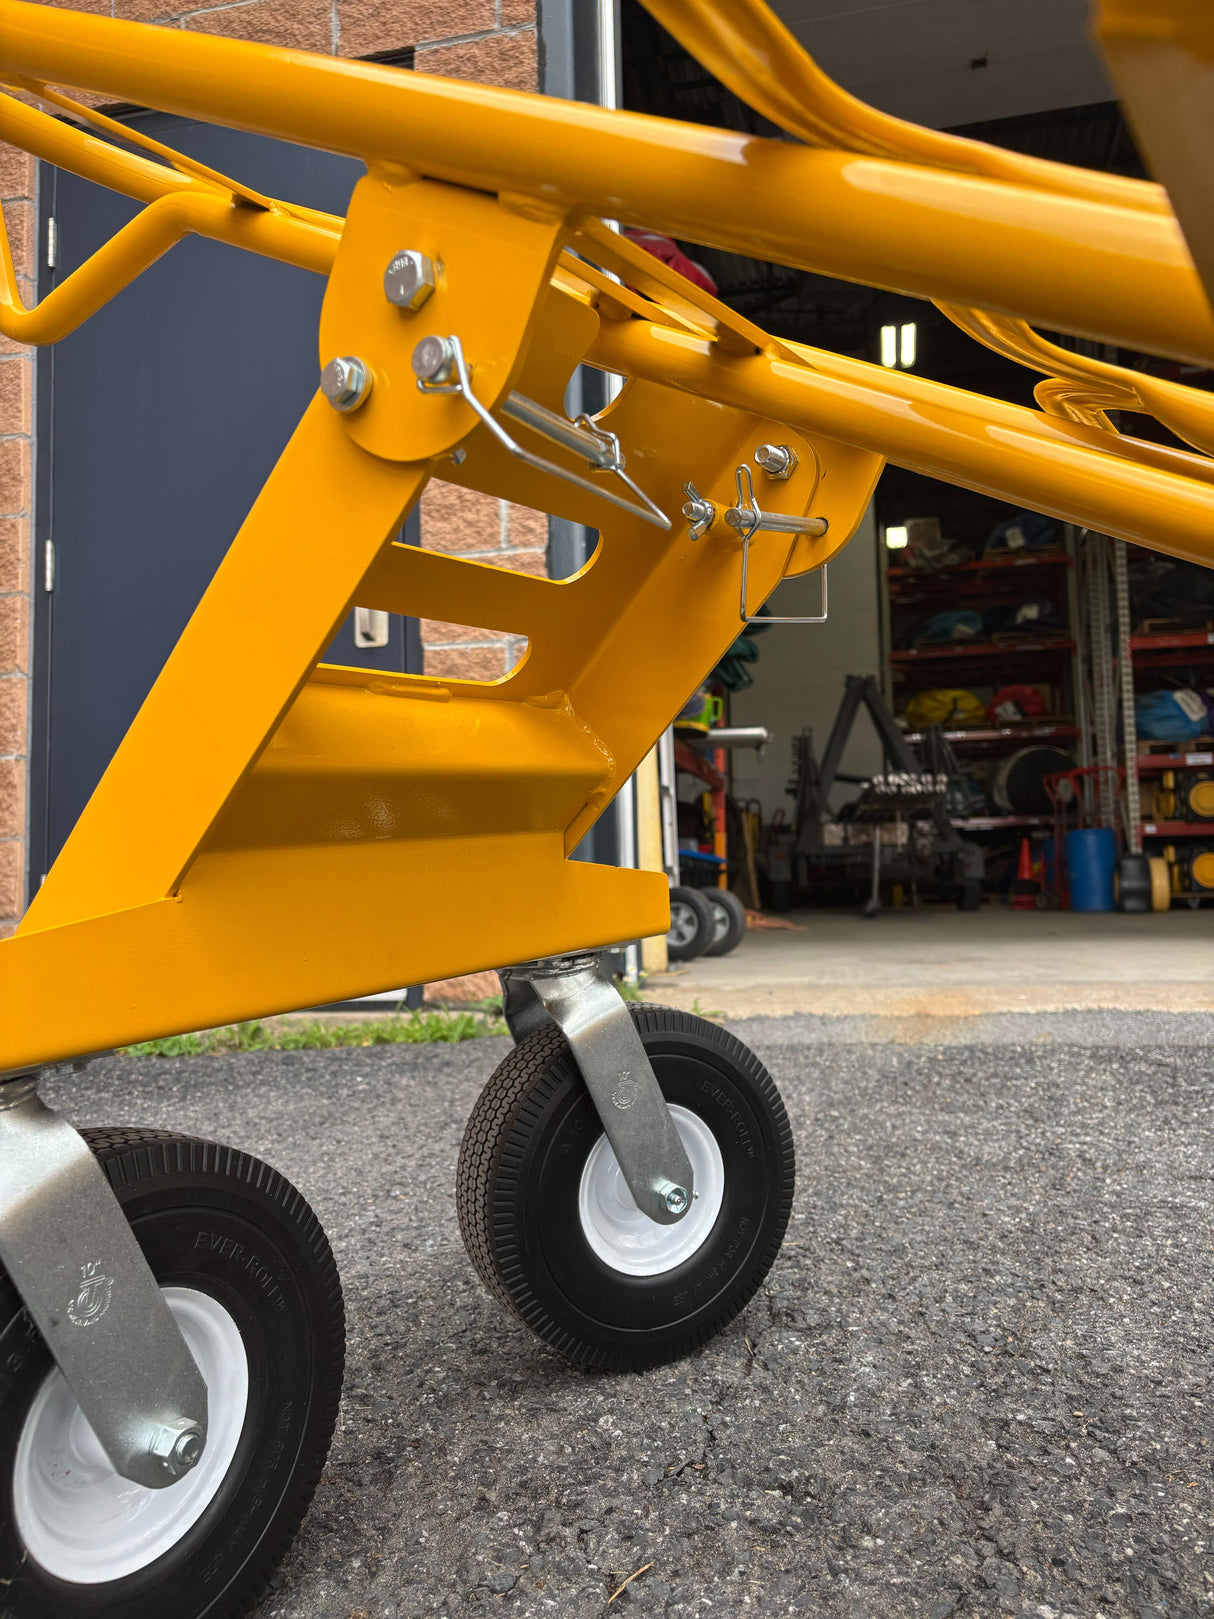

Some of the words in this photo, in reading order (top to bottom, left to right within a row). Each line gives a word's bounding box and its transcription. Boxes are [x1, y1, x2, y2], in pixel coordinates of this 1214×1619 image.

[724, 1240, 740, 1260] FOR
[278, 1400, 295, 1432] NOT
[268, 1440, 284, 1471] FOR
